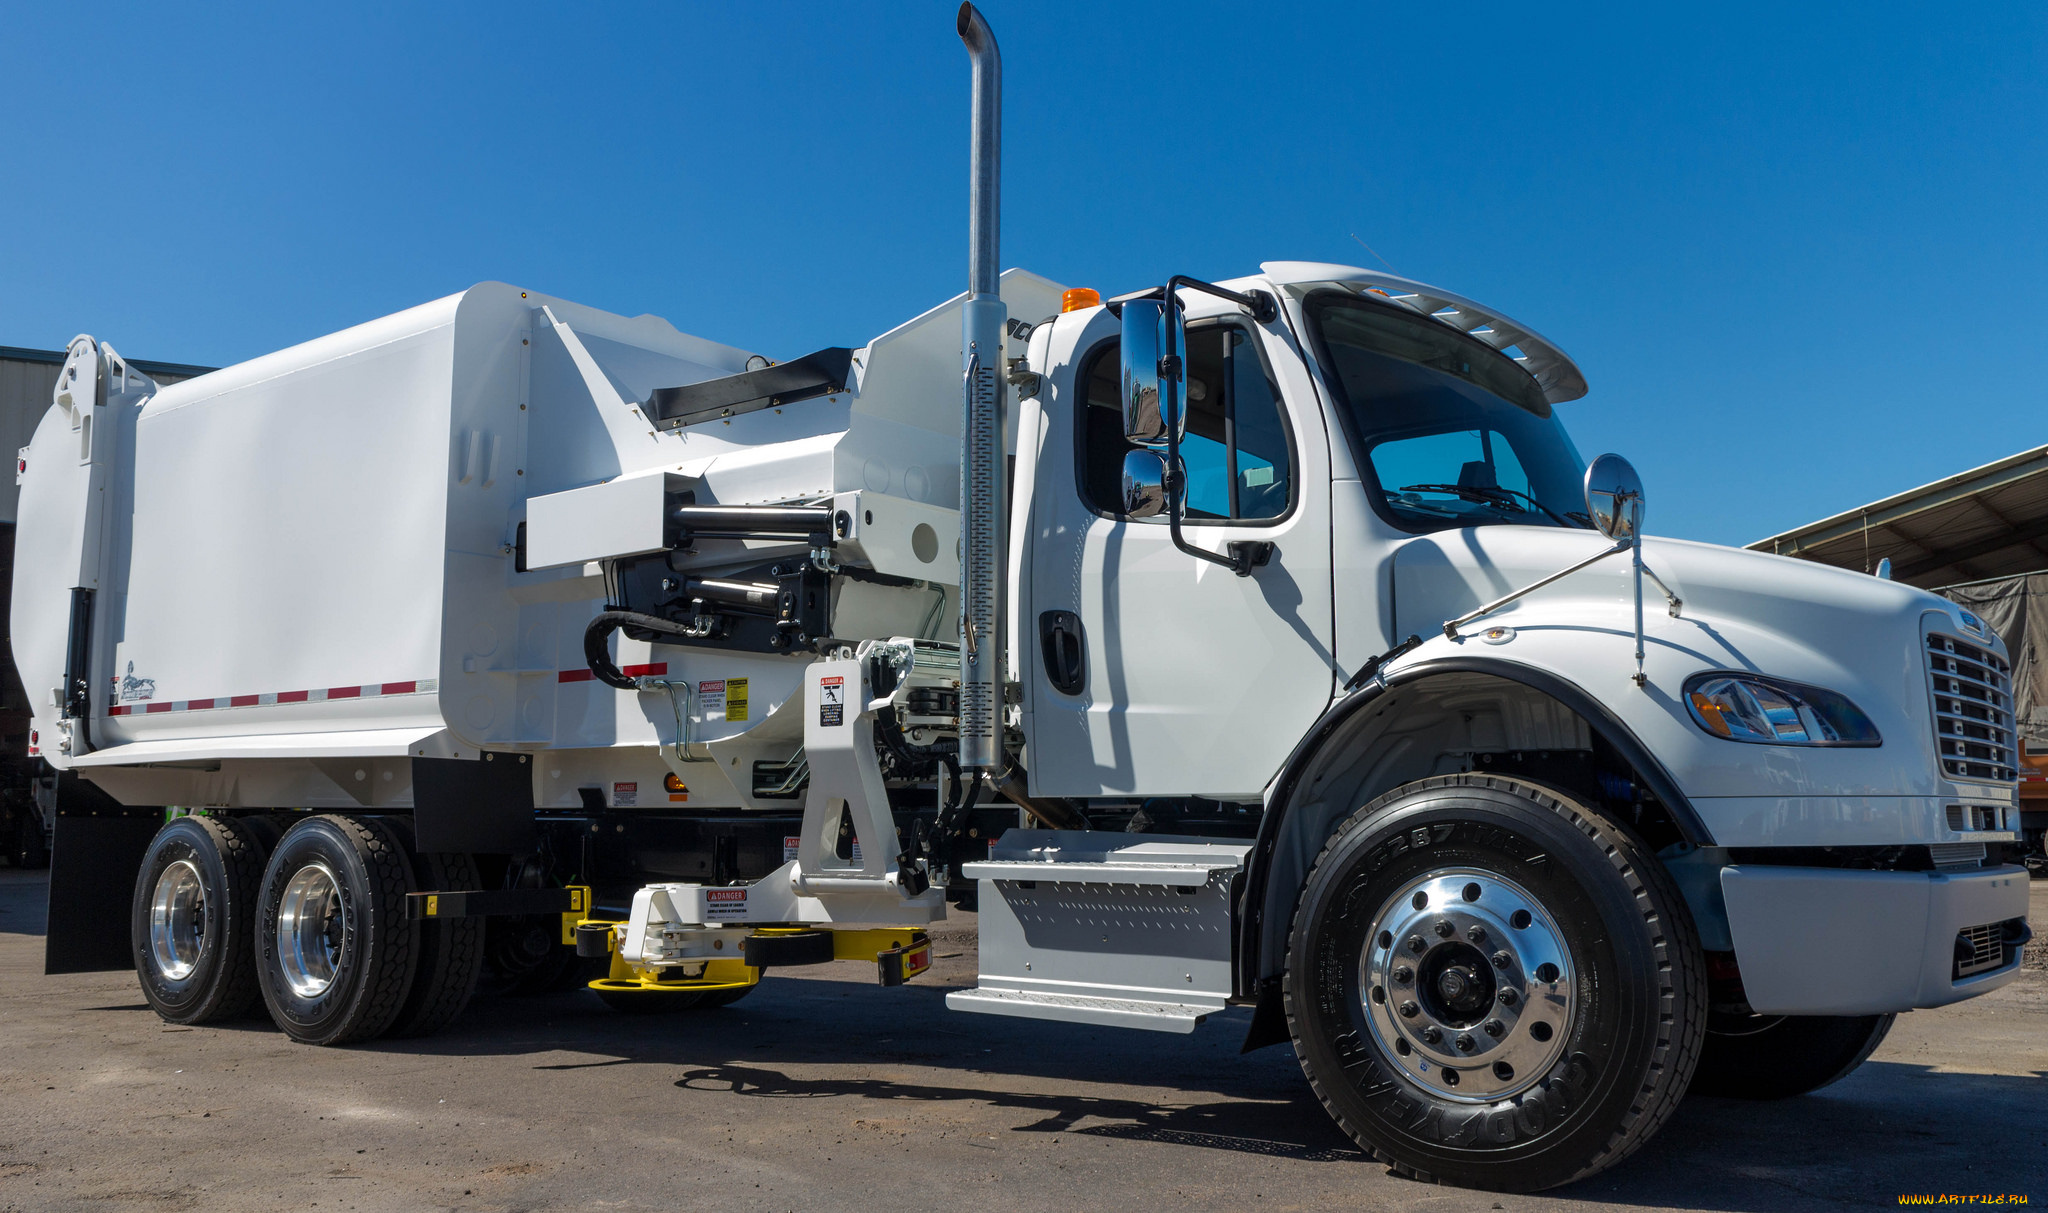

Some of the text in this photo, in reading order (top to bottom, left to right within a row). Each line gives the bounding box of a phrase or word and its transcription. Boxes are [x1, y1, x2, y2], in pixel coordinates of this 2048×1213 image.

[705, 682, 723, 690] DANGER
[717, 892, 743, 900] DANGER
[1333, 1029, 1596, 1148] GOODYEAR
